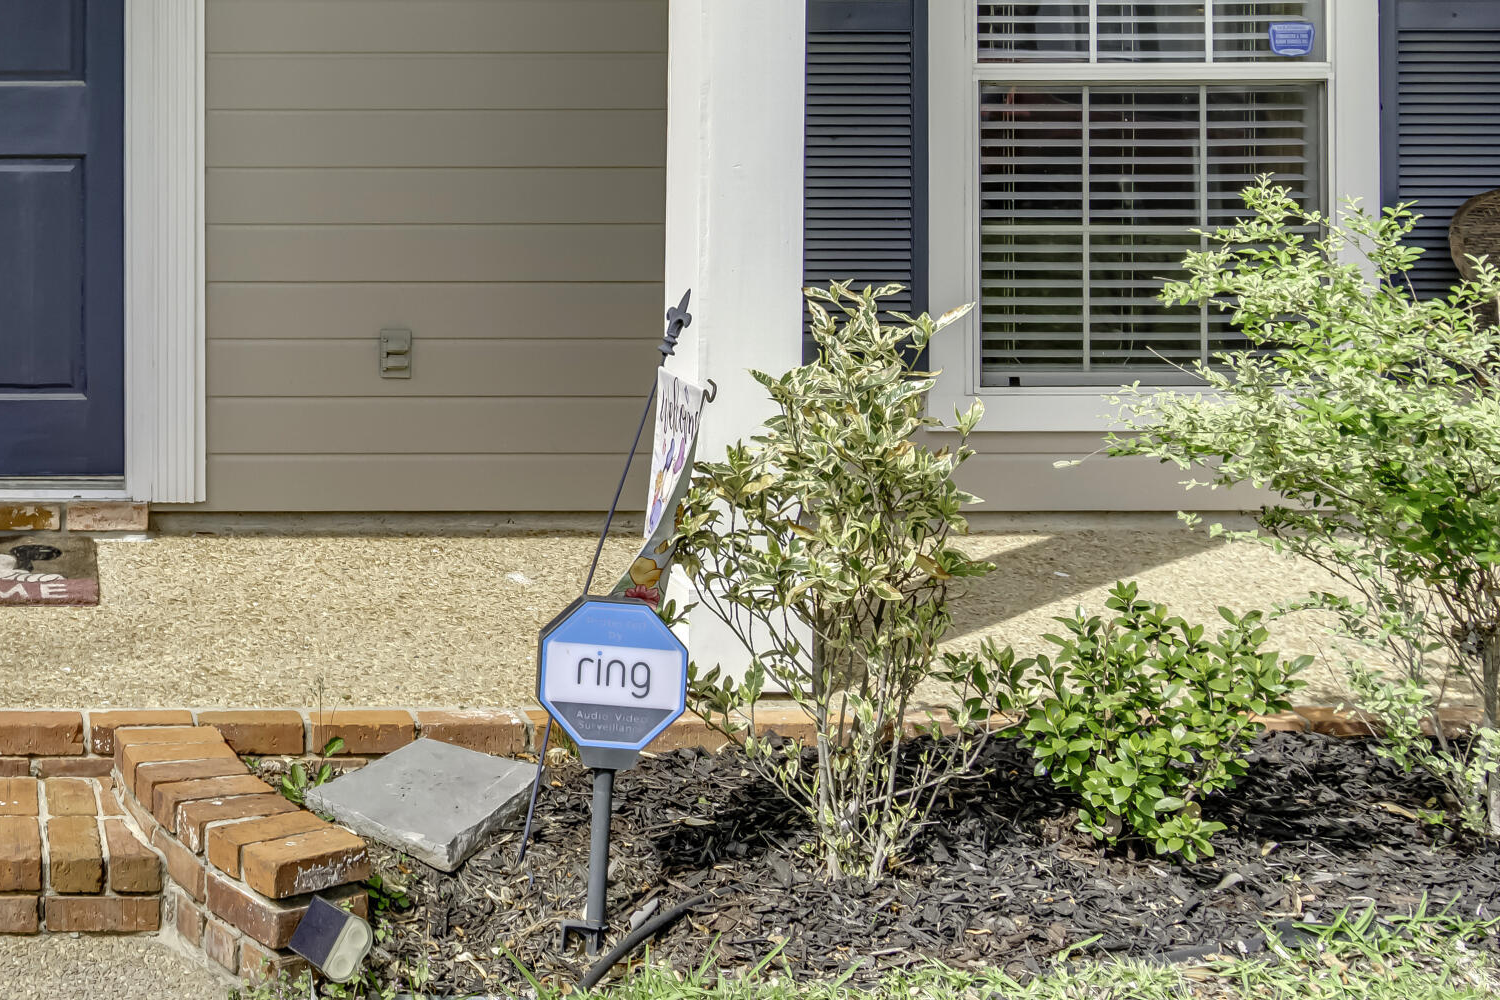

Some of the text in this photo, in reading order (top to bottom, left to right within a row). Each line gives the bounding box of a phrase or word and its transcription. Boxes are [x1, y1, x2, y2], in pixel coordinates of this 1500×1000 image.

[577, 650, 651, 699] ring
[576, 710, 648, 724] Audio Video
